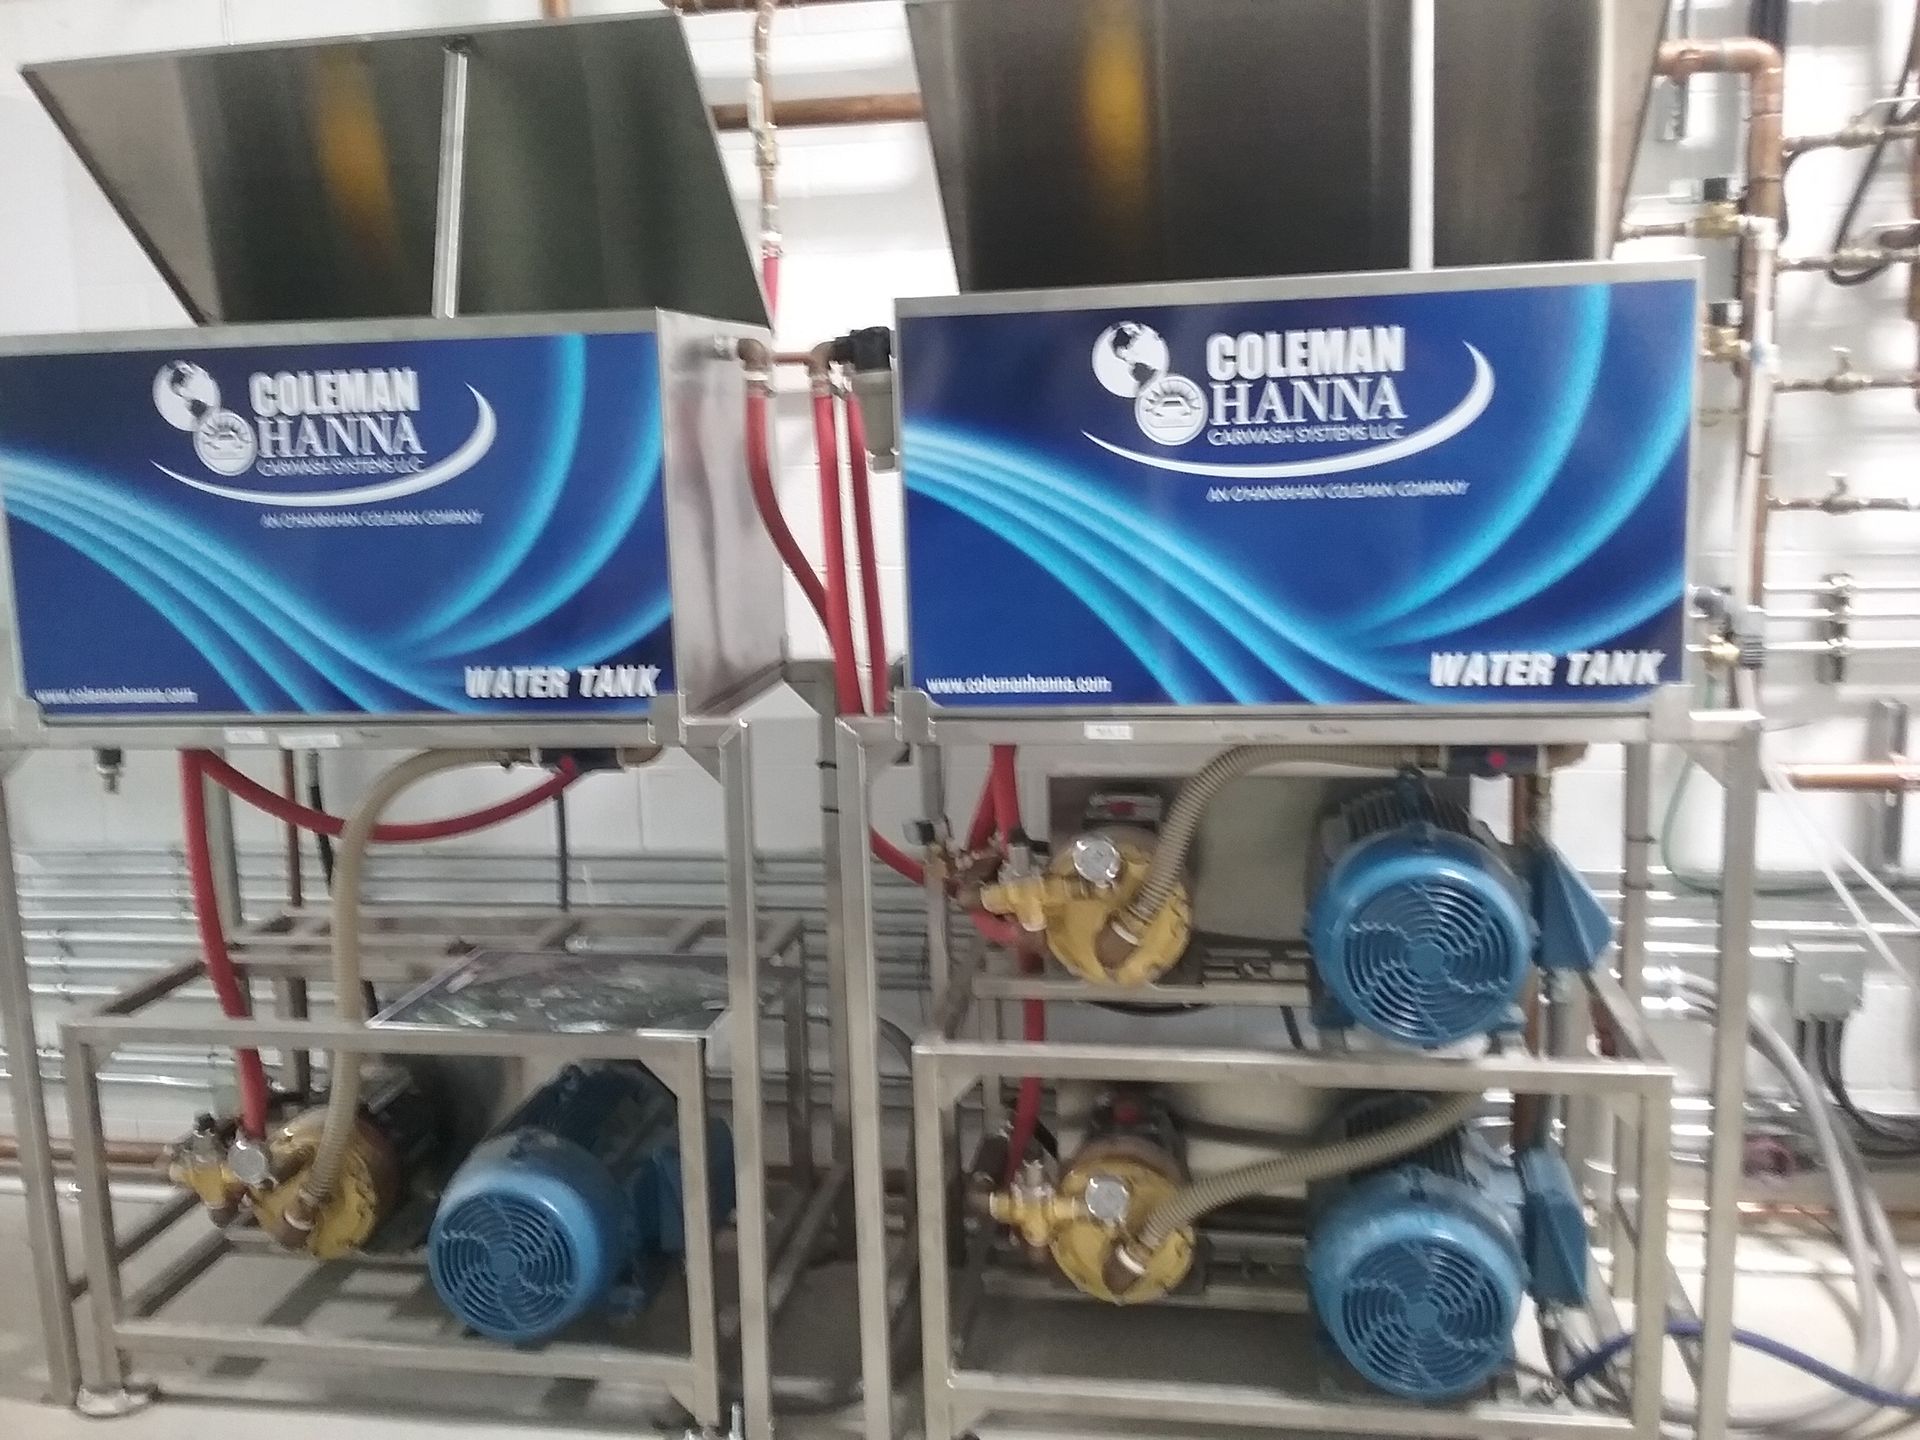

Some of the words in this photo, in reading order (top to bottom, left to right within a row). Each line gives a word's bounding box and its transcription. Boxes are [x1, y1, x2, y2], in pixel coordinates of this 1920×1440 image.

[1206, 324, 1405, 380] COLEMAN
[249, 366, 420, 417] COLEMAN
[1209, 376, 1408, 426] HANNA
[254, 412, 427, 459] HANNA
[1207, 427, 1295, 446] CARWASH
[1294, 425, 1369, 443] SYSTEMS
[1369, 422, 1404, 440] LLC
[1324, 481, 1397, 499] COLEMAN
[1397, 479, 1471, 497] COMPANY
[464, 665, 570, 699] WATER
[577, 664, 662, 698] TANK
[1430, 651, 1557, 687] WATER
[1565, 650, 1667, 686] TANK
